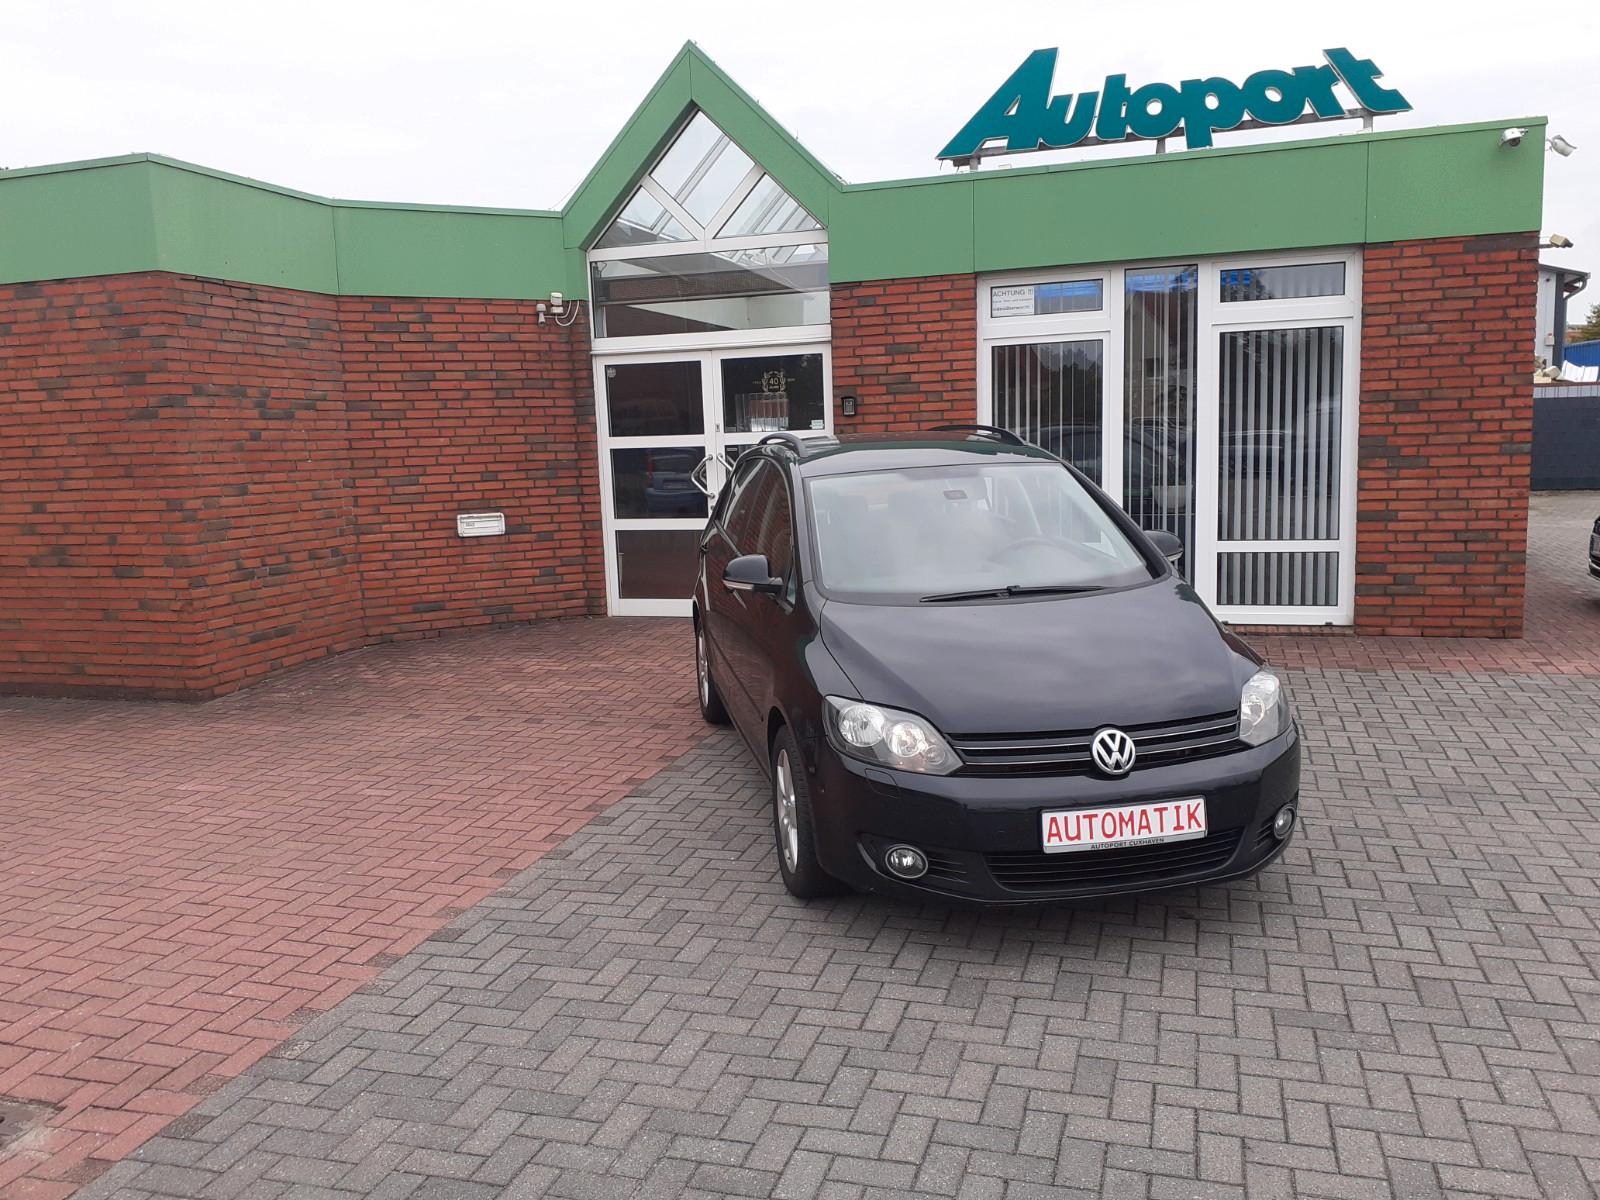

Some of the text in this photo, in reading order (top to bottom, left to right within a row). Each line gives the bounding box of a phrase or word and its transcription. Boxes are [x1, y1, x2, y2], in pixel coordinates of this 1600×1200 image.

[937, 47, 1412, 157] Autoport
[992, 289, 1025, 298] ACHTUNG
[1093, 728, 1136, 774] VW
[1047, 802, 1202, 843] AUTOMATIK
[1090, 837, 1165, 850] AUTOPORT CUXHAVEN
